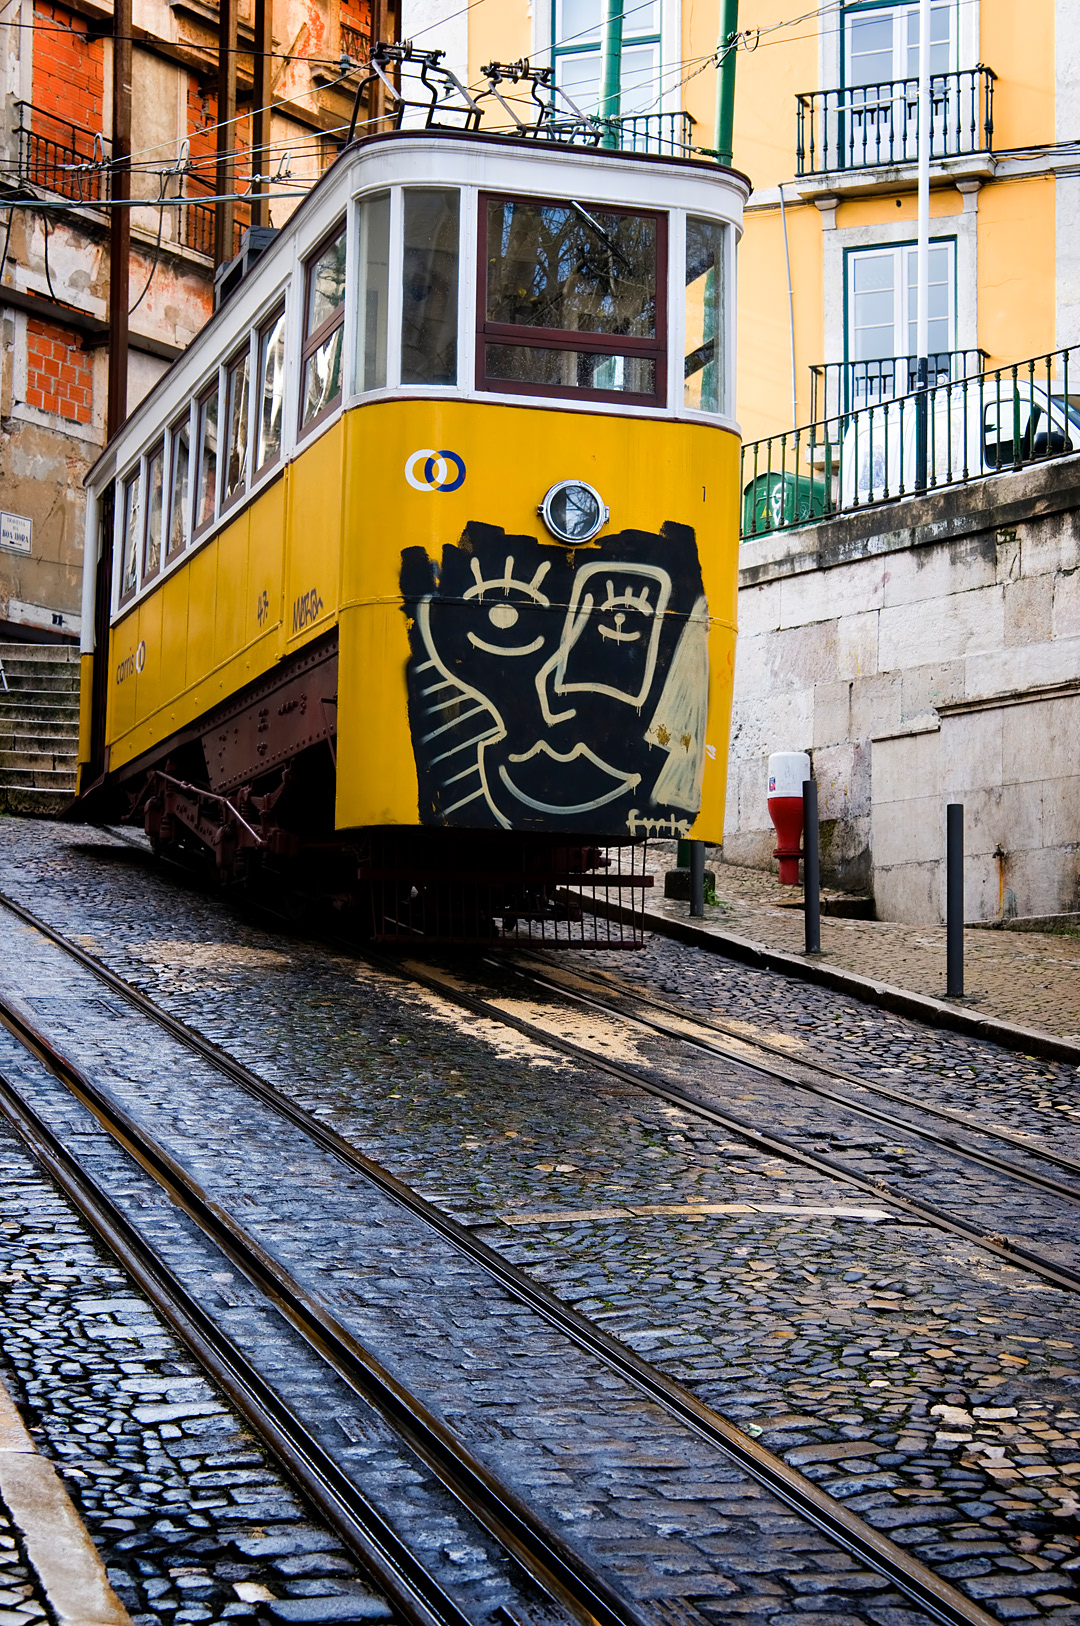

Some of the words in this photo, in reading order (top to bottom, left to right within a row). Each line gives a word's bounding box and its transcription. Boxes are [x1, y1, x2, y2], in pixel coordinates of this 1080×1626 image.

[2, 529, 13, 539] BOA
[14, 532, 29, 543] HORA
[117, 654, 135, 685] carris
